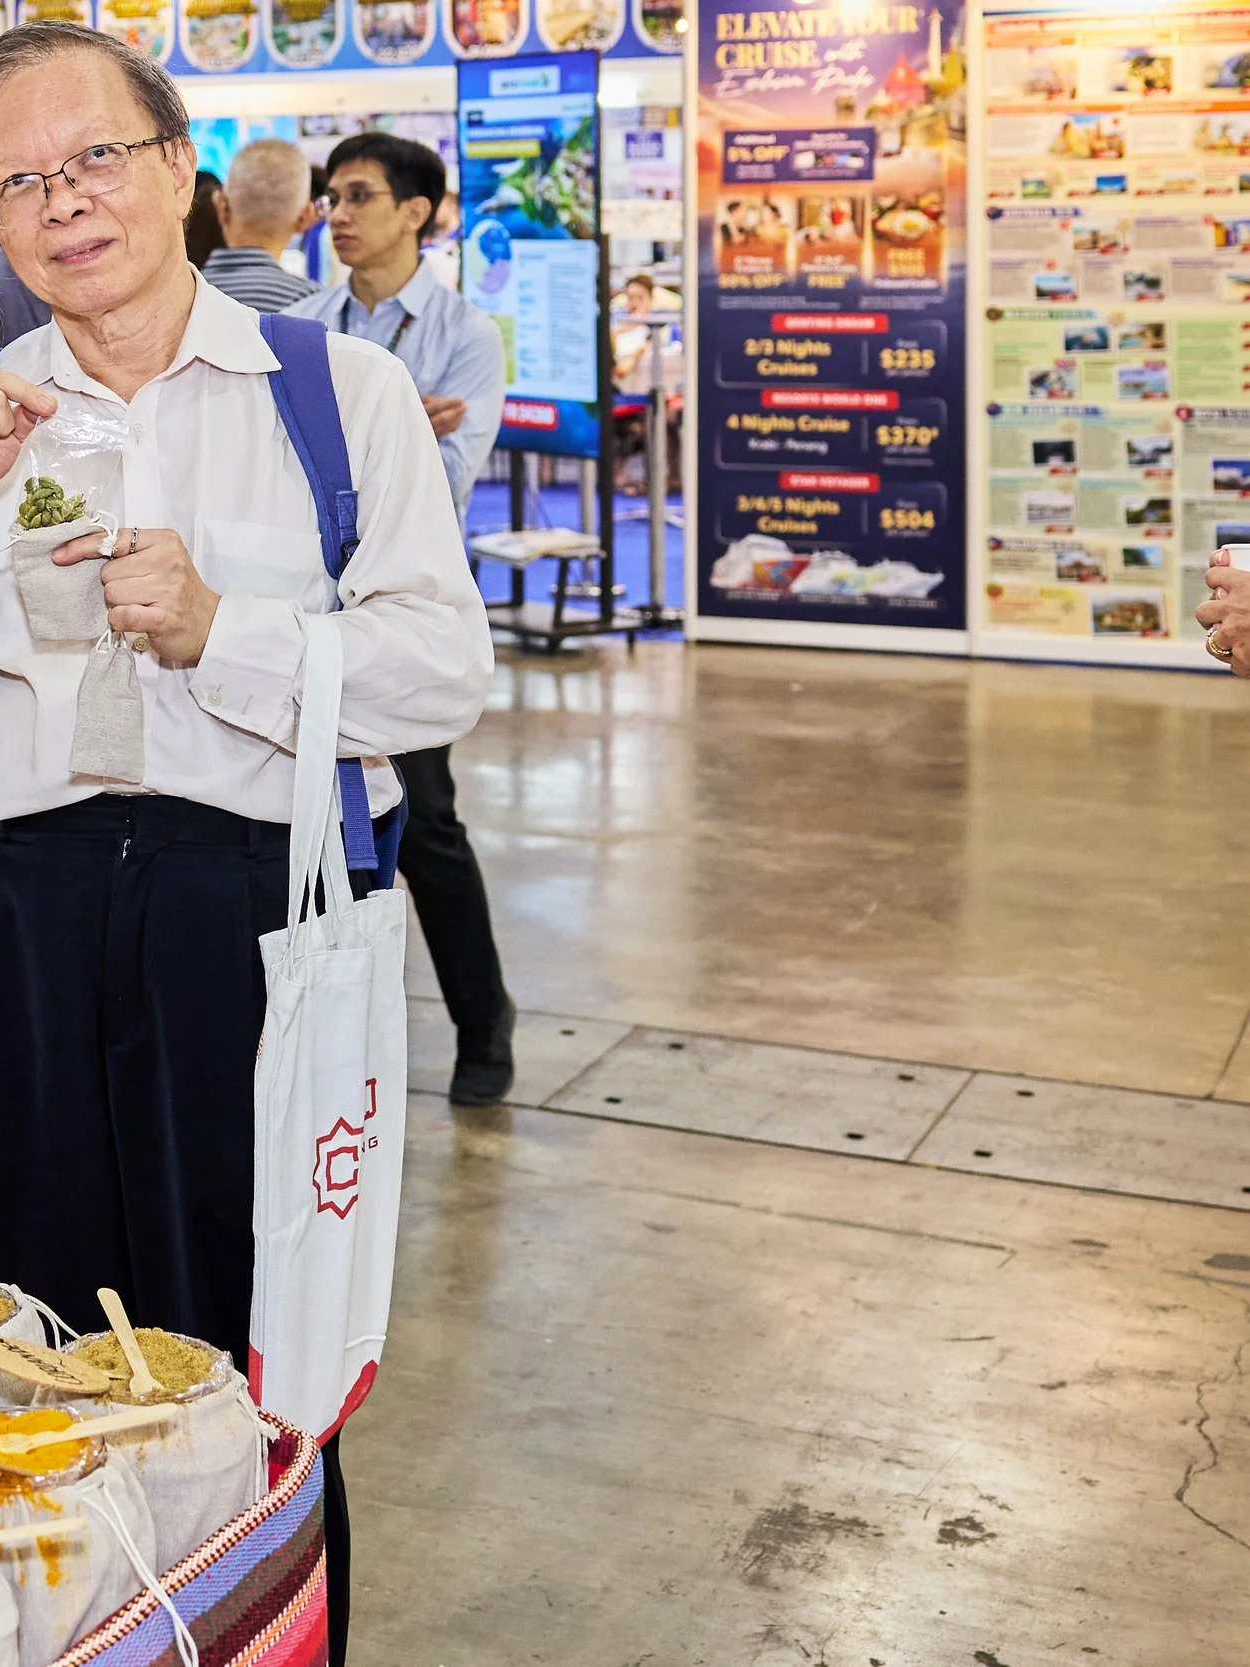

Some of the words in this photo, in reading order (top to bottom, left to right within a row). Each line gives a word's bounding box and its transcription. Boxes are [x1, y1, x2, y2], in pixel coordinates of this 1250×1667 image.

[716, 11, 834, 41] ELEVATE
[716, 41, 821, 68] CRUISE
[745, 338, 774, 356] 2/3
[775, 338, 832, 359] Nights
[879, 348, 936, 369] $235
[757, 358, 818, 377] Cruises
[726, 414, 739, 430] 4
[740, 414, 796, 434] Nights
[797, 414, 850, 432] Cruise
[736, 495, 782, 513] 3/4/5
[784, 496, 840, 517] Nights
[757, 516, 818, 534] Cruises
[879, 508, 935, 530] $504
